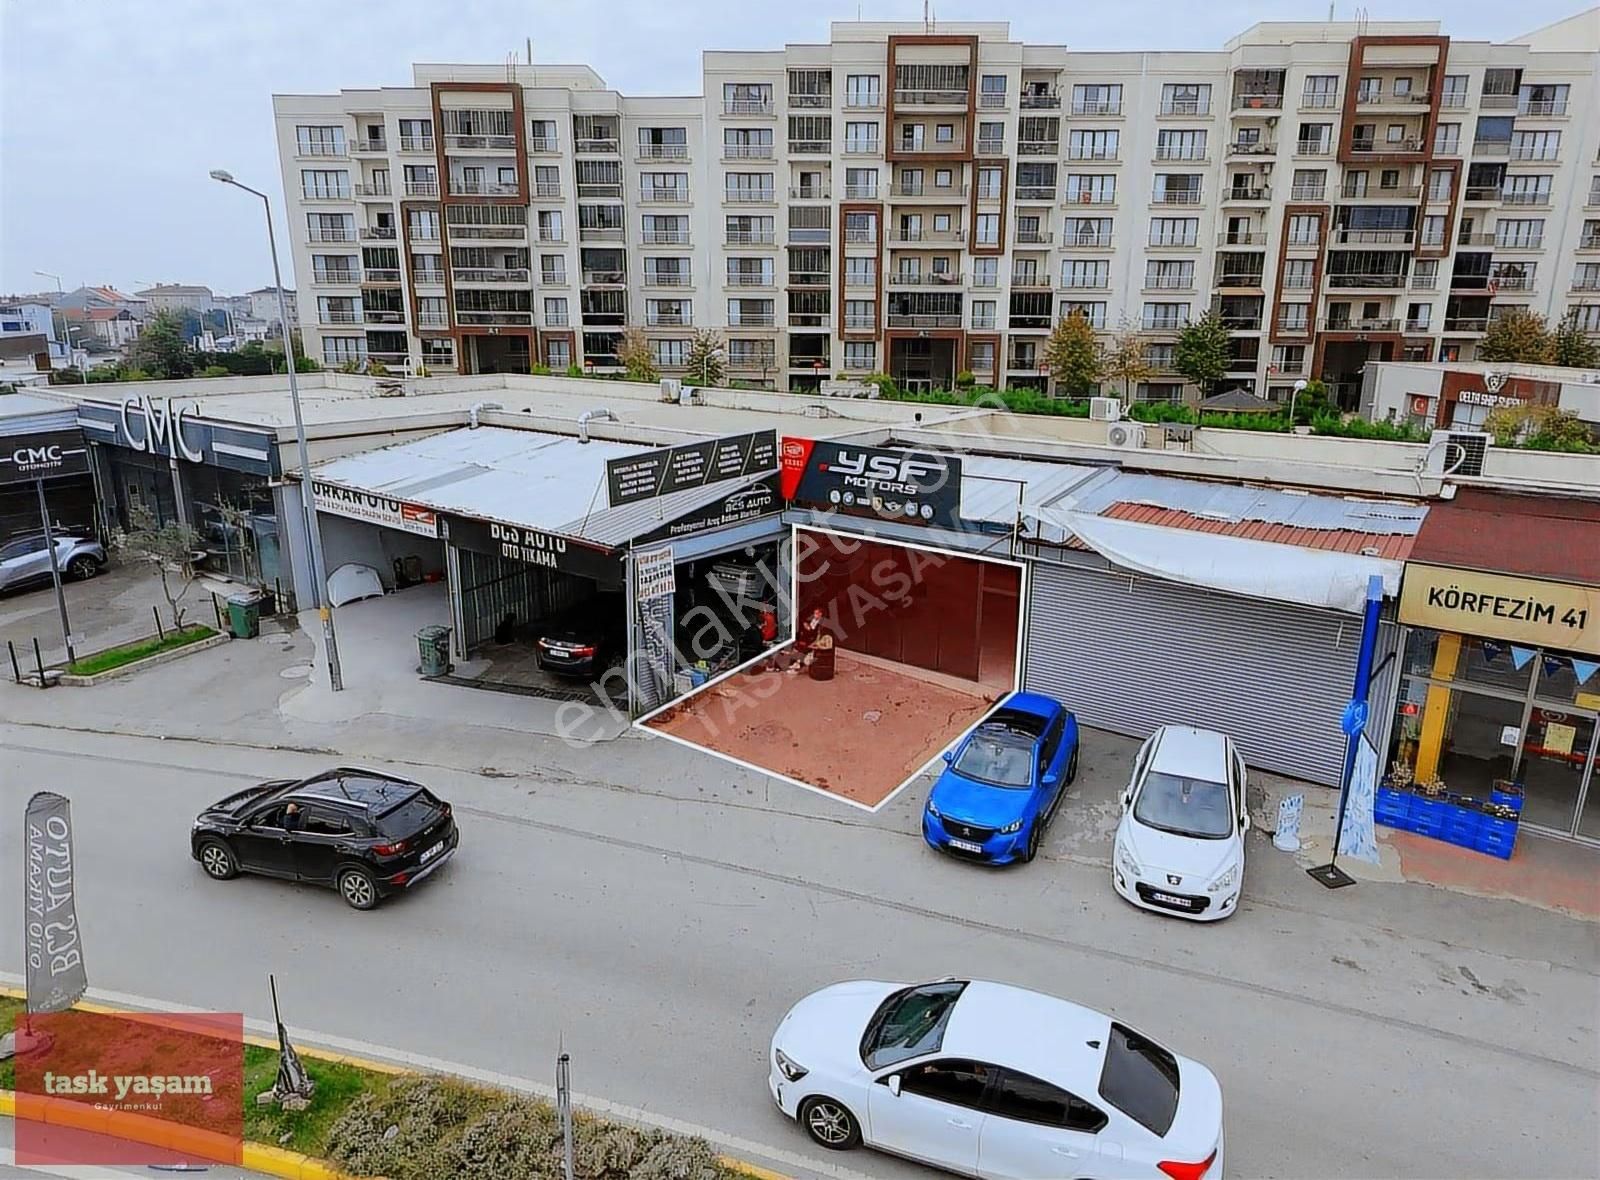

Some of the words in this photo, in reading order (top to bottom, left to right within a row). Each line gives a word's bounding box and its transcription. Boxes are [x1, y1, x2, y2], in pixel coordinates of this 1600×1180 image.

[121, 393, 203, 463] CMC
[13, 445, 62, 465] CMC
[827, 450, 947, 482] YSF
[844, 475, 918, 495] MOTORS
[368, 496, 400, 513] OTO
[746, 496, 771, 509] AUTO
[524, 531, 566, 553] AUTO
[502, 543, 519, 559] OTO
[520, 546, 558, 569] YIKAMA
[1428, 584, 1556, 625] KÖRFEZİM
[1560, 608, 1588, 629] 41
